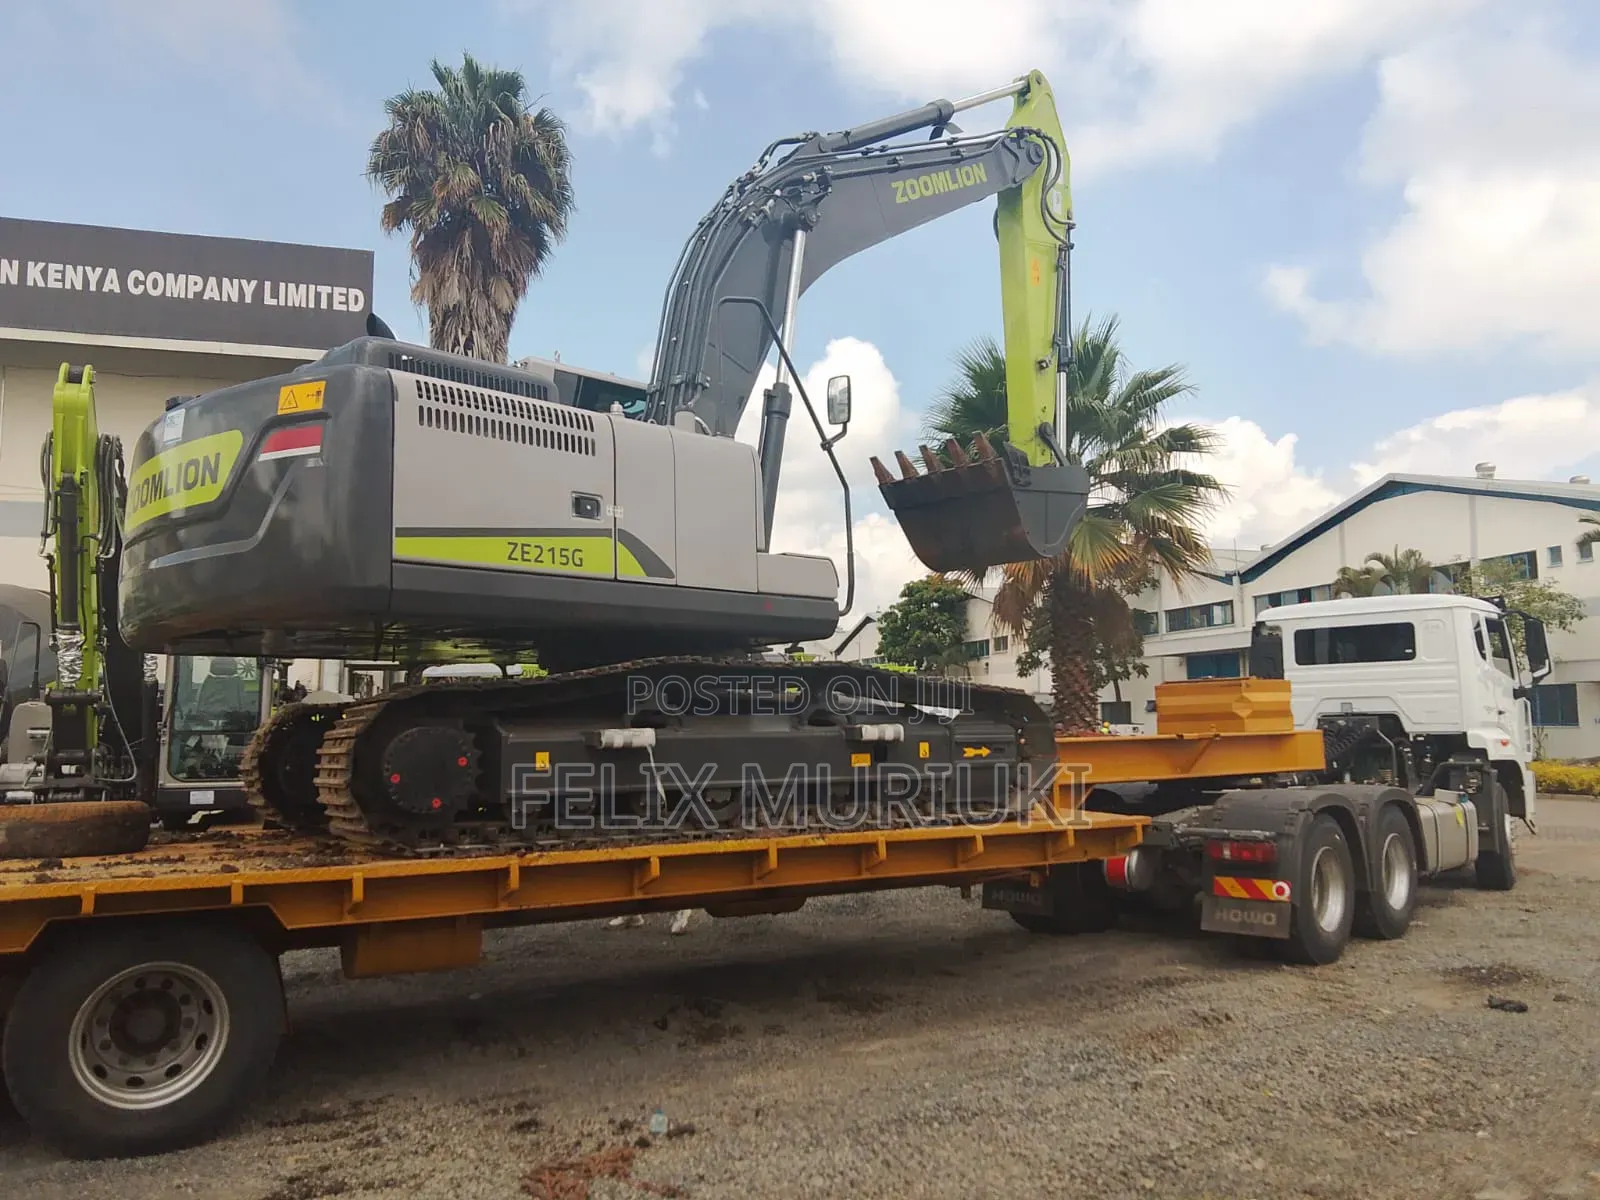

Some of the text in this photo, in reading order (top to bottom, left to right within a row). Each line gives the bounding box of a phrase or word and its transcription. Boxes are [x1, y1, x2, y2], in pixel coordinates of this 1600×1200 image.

[891, 162, 988, 204] ZOOMLION
[26, 261, 121, 294] KENYA
[127, 269, 258, 304] COMPANY
[263, 280, 366, 313] LIMITED
[127, 452, 221, 518] OOMLION
[507, 541, 584, 568] ZE215G
[1215, 908, 1277, 925] HOWO
